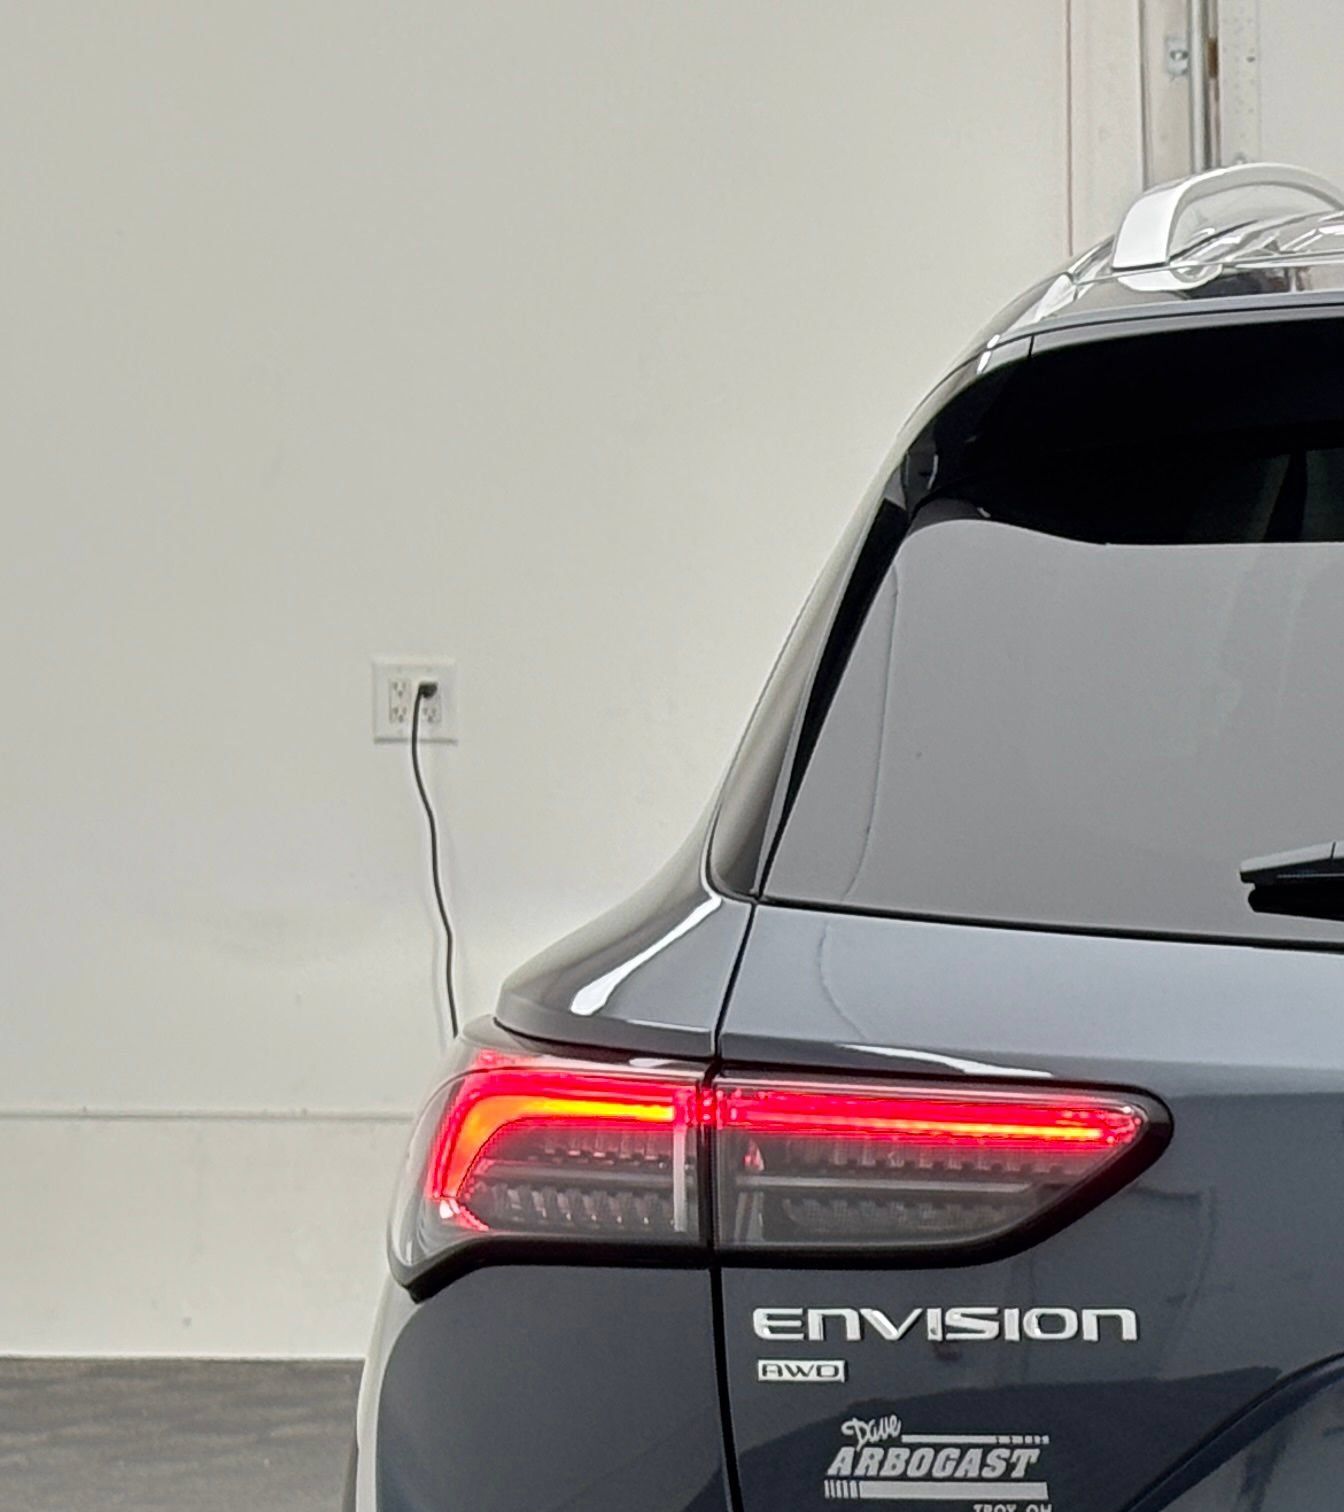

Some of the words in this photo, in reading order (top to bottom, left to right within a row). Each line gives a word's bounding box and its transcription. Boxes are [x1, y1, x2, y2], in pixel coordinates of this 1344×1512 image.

[752, 1307, 1137, 1342] ENVISION
[760, 1362, 842, 1380] AWD
[841, 1414, 902, 1452] Dave
[826, 1446, 1041, 1479] ARBOGAST
